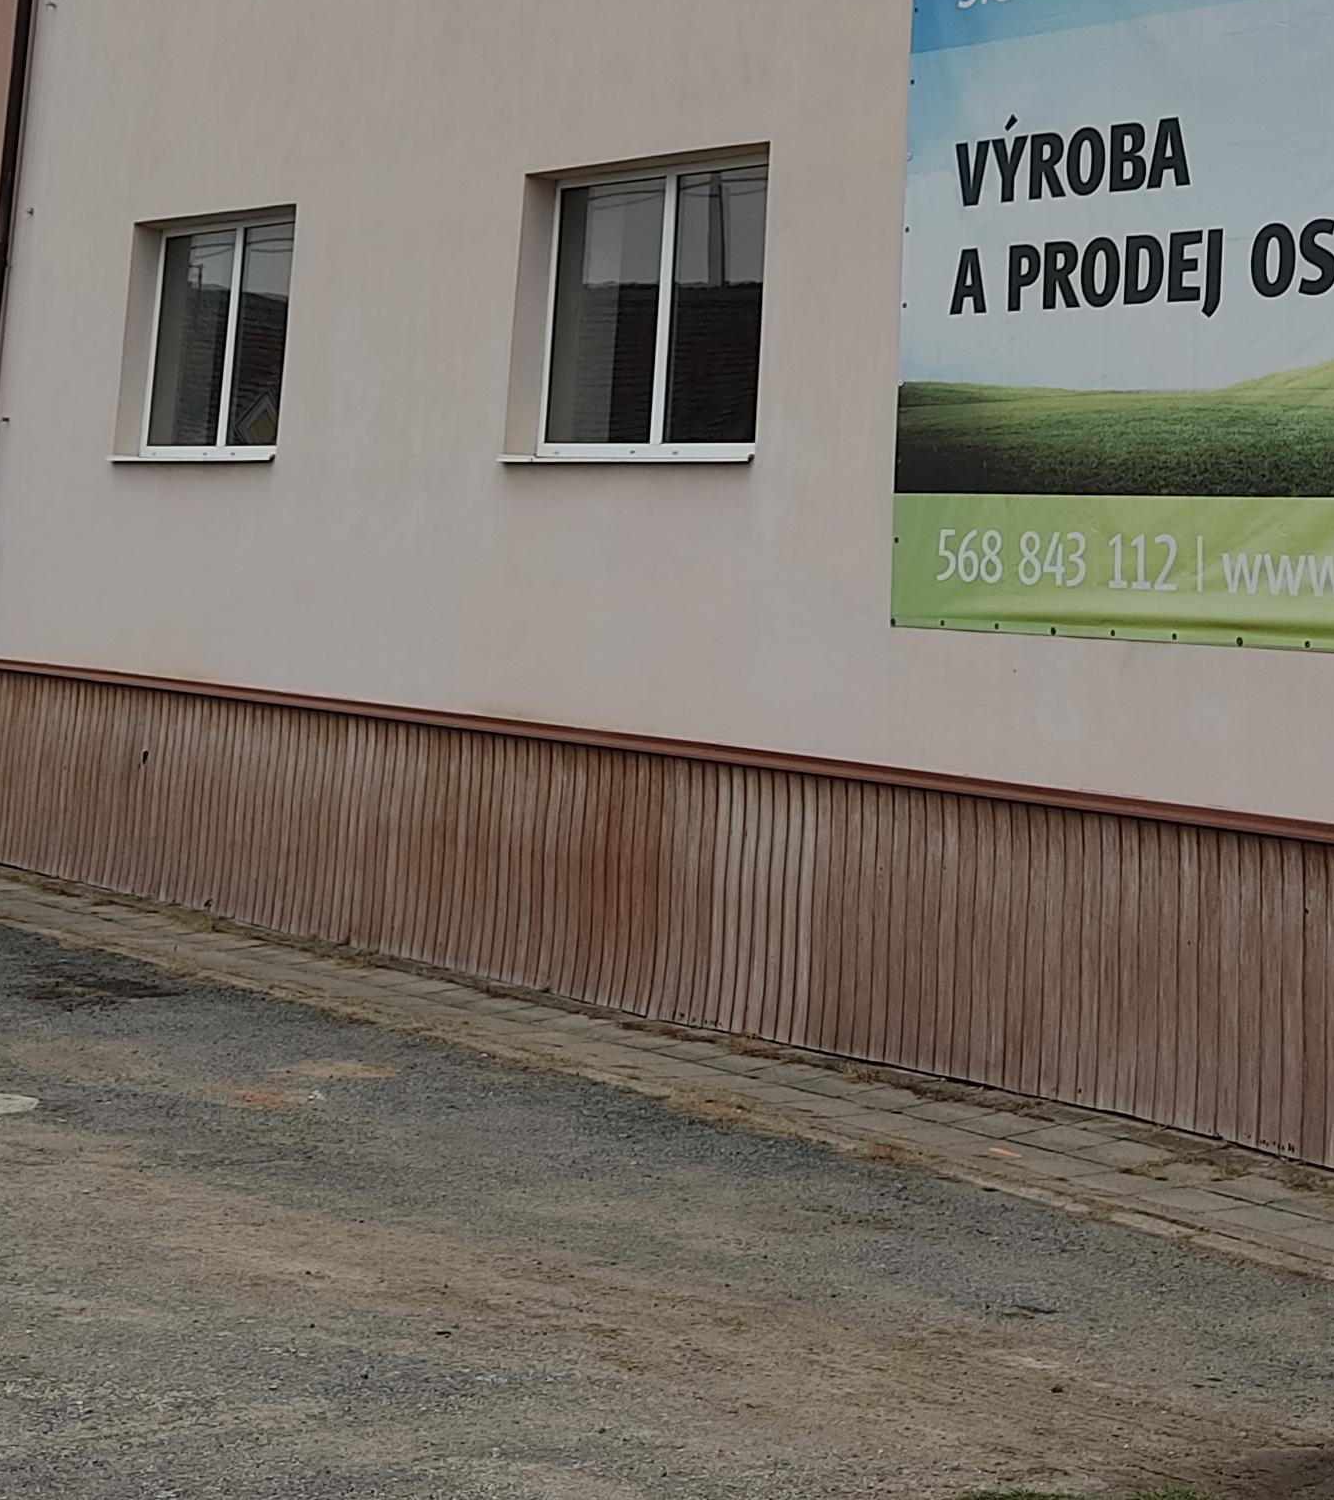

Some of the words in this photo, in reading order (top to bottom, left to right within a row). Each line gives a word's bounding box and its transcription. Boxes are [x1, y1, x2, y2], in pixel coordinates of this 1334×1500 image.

[955, 114, 1191, 206] VÝROBA
[949, 248, 987, 315] A
[1007, 228, 1225, 318] PRODEJ
[936, 529, 1003, 584] 568
[1018, 531, 1086, 588] 843
[1107, 534, 1178, 591] 112
